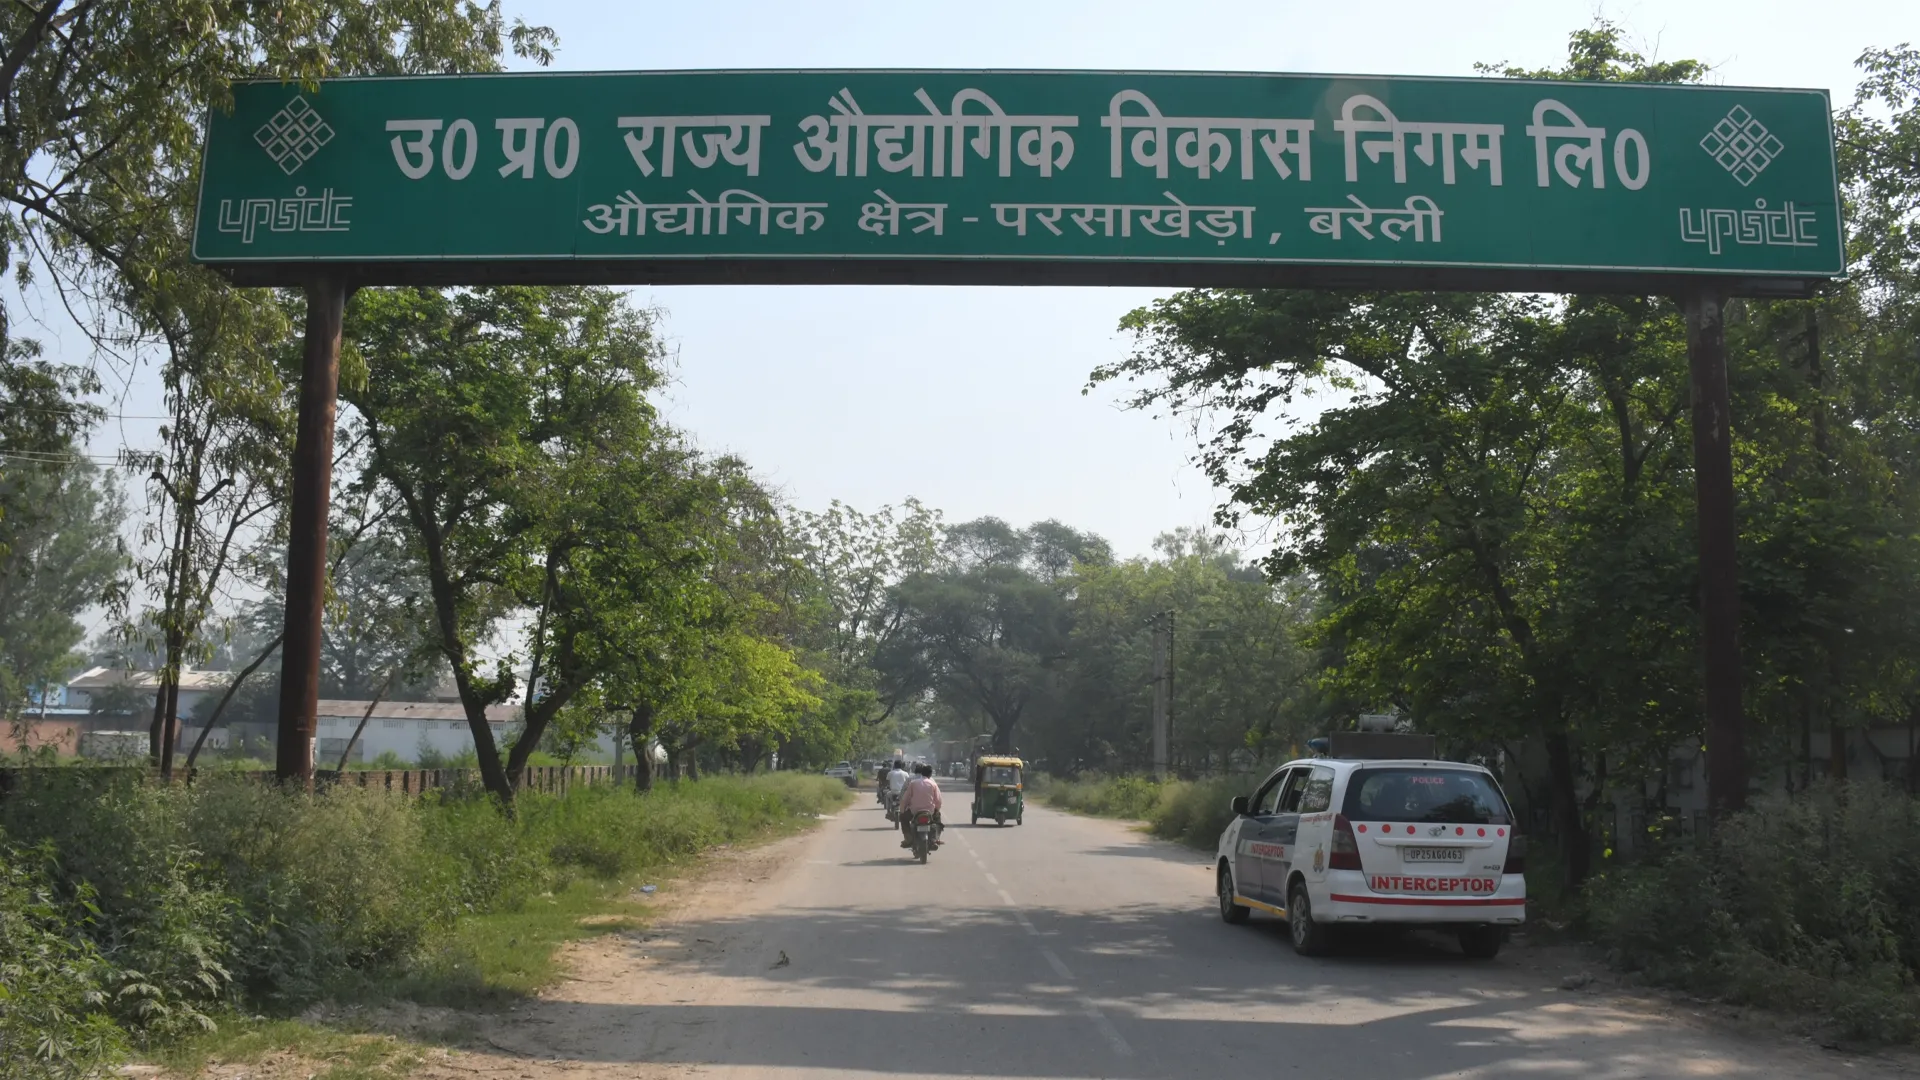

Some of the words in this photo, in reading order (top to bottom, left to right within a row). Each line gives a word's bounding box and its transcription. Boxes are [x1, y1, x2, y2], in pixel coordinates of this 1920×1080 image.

[617, 115, 771, 177] राज्य
[793, 88, 1079, 178] औद्योगिक
[1101, 89, 1315, 182] विकास
[1333, 94, 1505, 186] निगम
[582, 190, 829, 236] औद्योगिक
[857, 189, 949, 236] क्षेत्र
[1303, 194, 1445, 243] बरेली
[1411, 776, 1445, 785] POLICE
[1250, 843, 1285, 859] INTERCEPTOR
[1371, 876, 1495, 892] INTERCEPTOR
